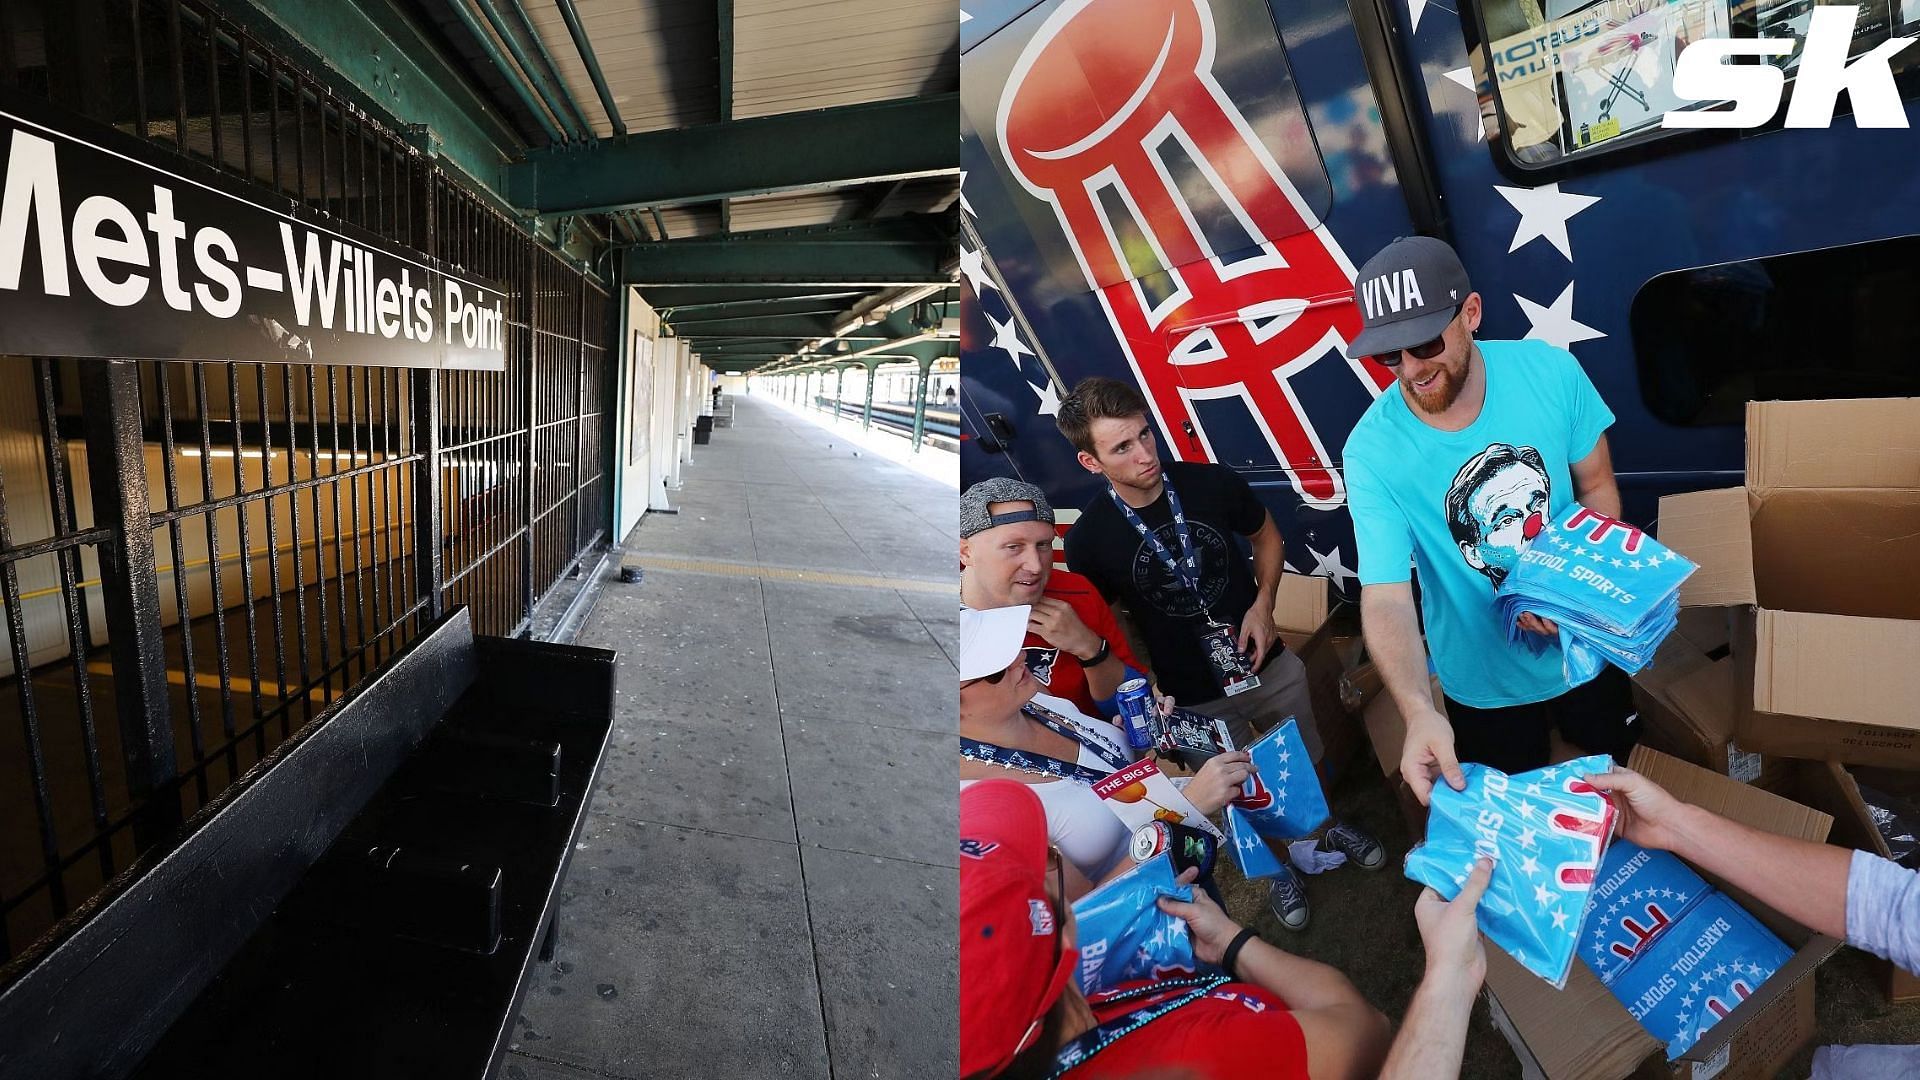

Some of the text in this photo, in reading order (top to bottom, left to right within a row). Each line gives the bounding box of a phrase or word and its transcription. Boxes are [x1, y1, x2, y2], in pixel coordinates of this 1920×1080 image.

[445, 279, 503, 351] Point
[1362, 268, 1425, 320] VIVA
[1568, 565, 1637, 605] SPORTS
[1097, 763, 1155, 795] THE BIG E
[1594, 850, 1652, 900] BARSTOOL
[1671, 916, 1732, 977] BARSTOOL
[1627, 973, 1678, 1022] SPORTS
